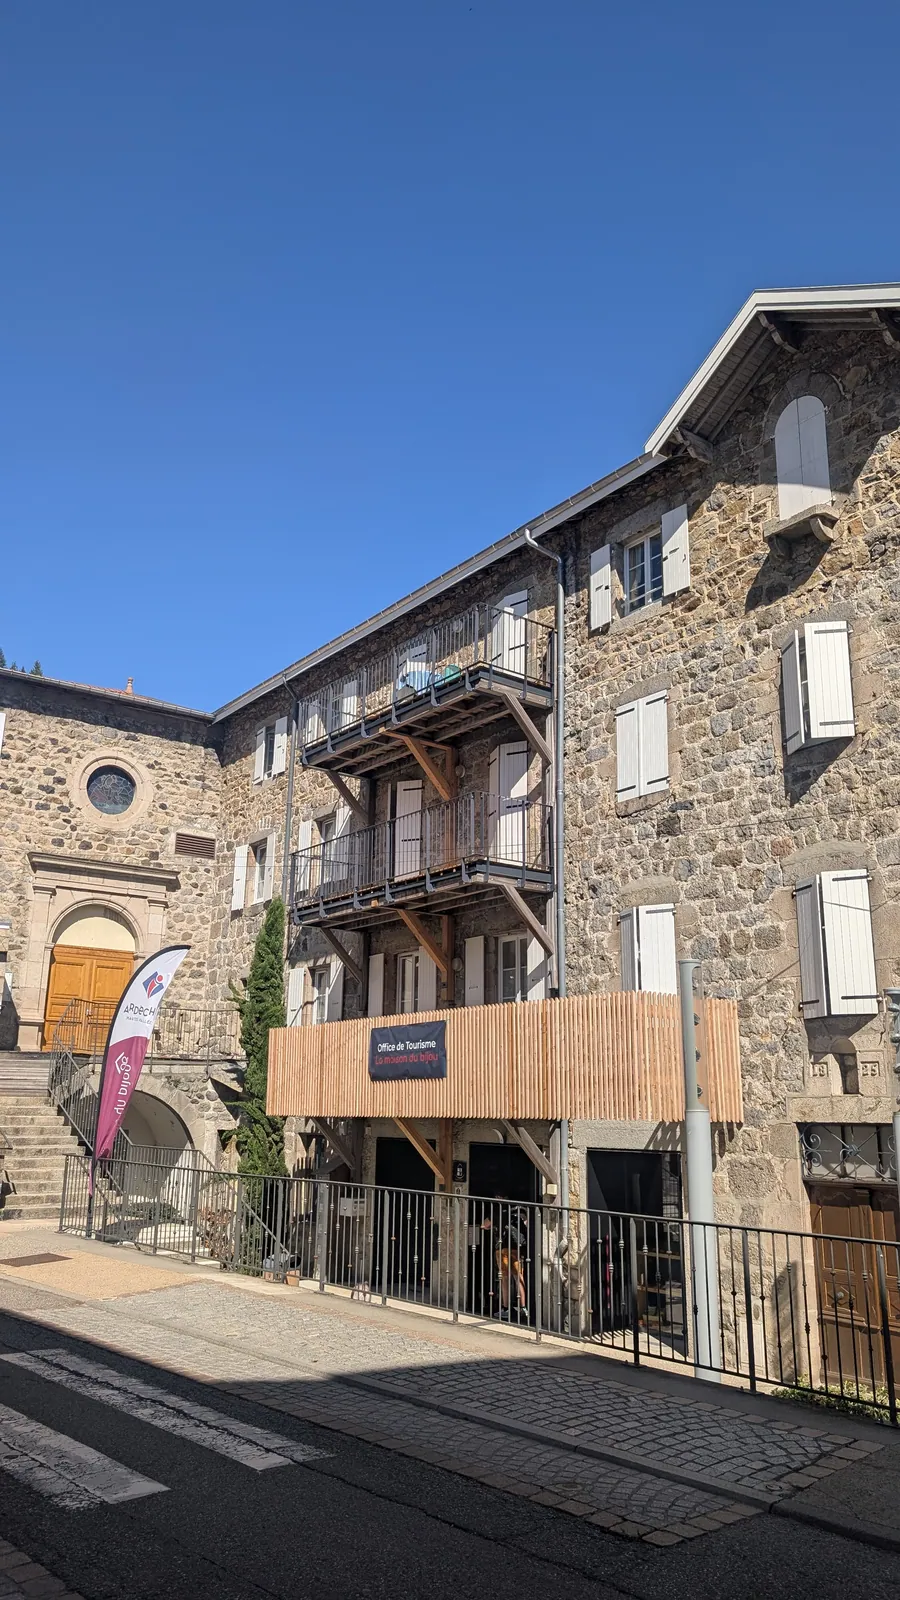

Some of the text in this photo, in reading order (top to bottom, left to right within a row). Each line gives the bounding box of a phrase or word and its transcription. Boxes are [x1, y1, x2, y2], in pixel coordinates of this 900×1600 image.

[377, 1039, 436, 1052] Office de Tourisme
[375, 1051, 438, 1065] La maison du bijou
[861, 1063, 878, 1077] 25
[114, 1100, 126, 1114] du
